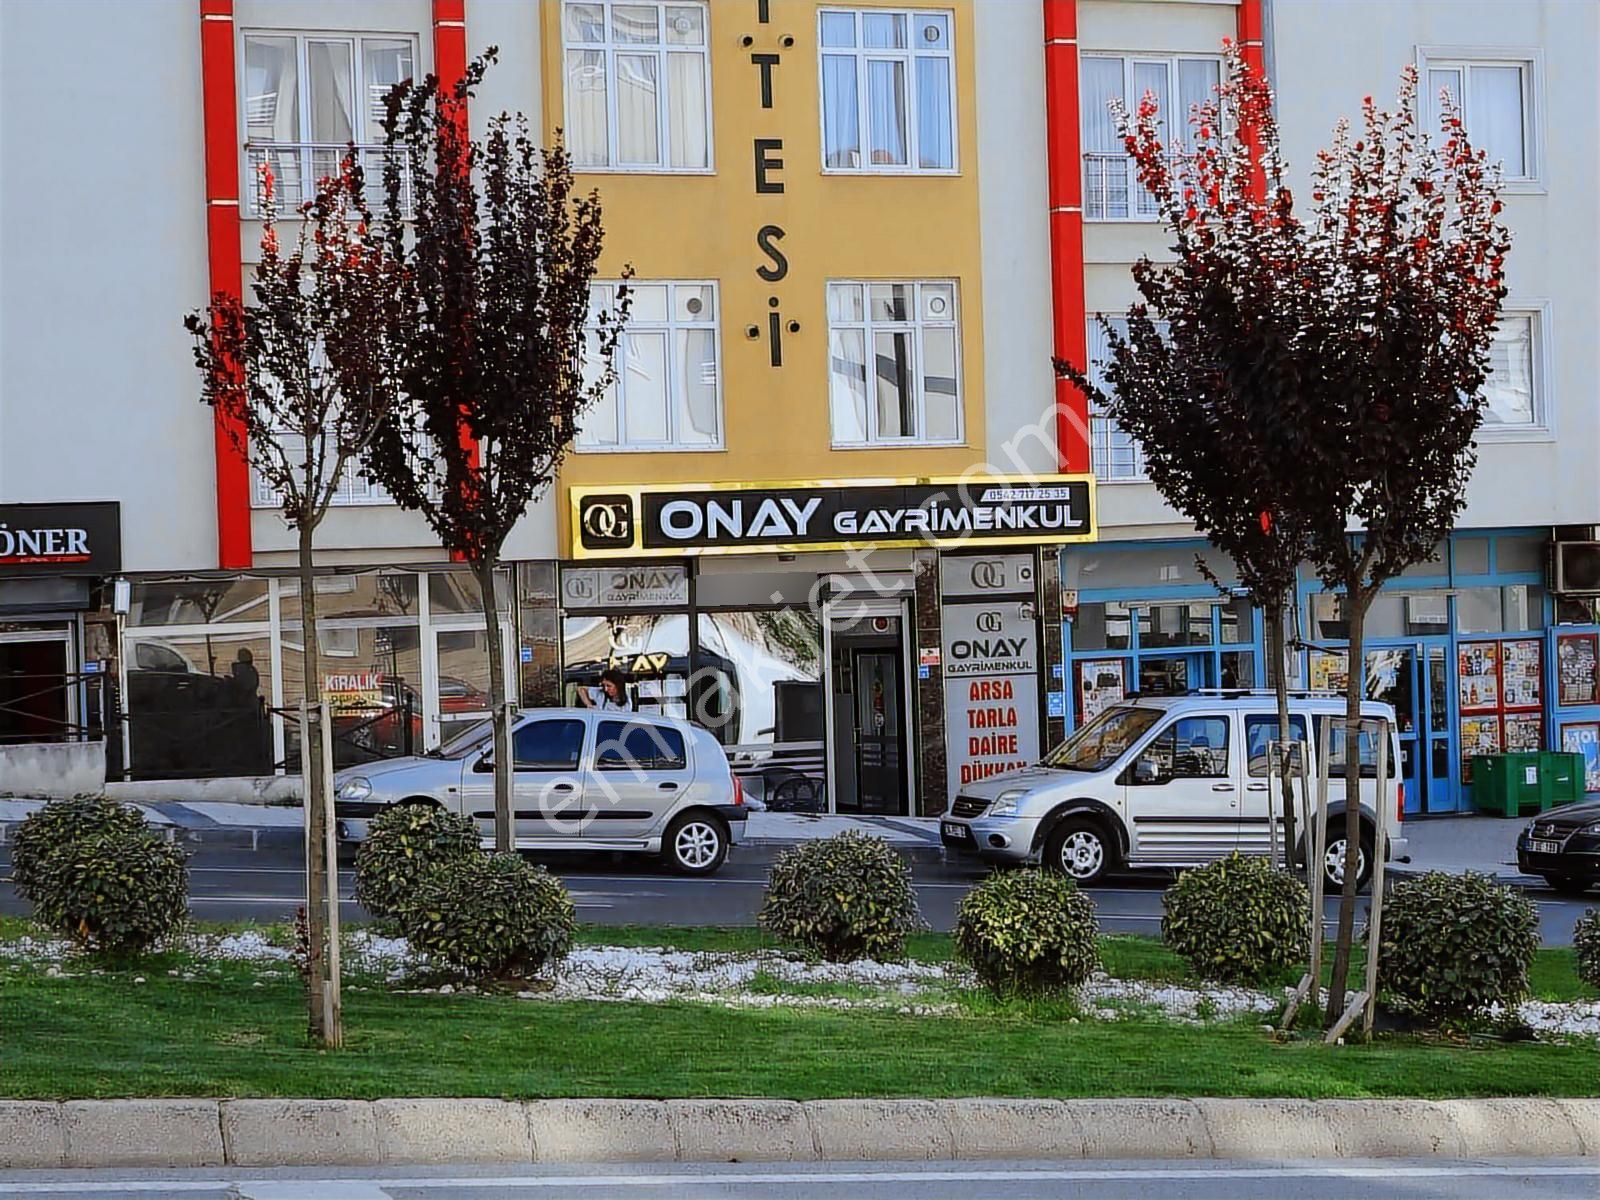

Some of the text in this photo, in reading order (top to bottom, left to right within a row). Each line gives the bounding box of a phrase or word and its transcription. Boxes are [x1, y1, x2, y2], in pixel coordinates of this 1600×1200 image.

[1017, 490, 1035, 500] 717
[1039, 489, 1051, 499] 25
[1054, 488, 1067, 498] 35
[583, 503, 628, 539] OG
[659, 497, 1084, 540] ONAY GAYRİMENKUL
[611, 571, 680, 590] ONAY
[951, 638, 1028, 659] ONAY
[947, 660, 1033, 673] GAYRİMENKUL
[969, 680, 1013, 701] ARSA
[967, 707, 1017, 728] TARLA
[968, 731, 1018, 756] DAİRE
